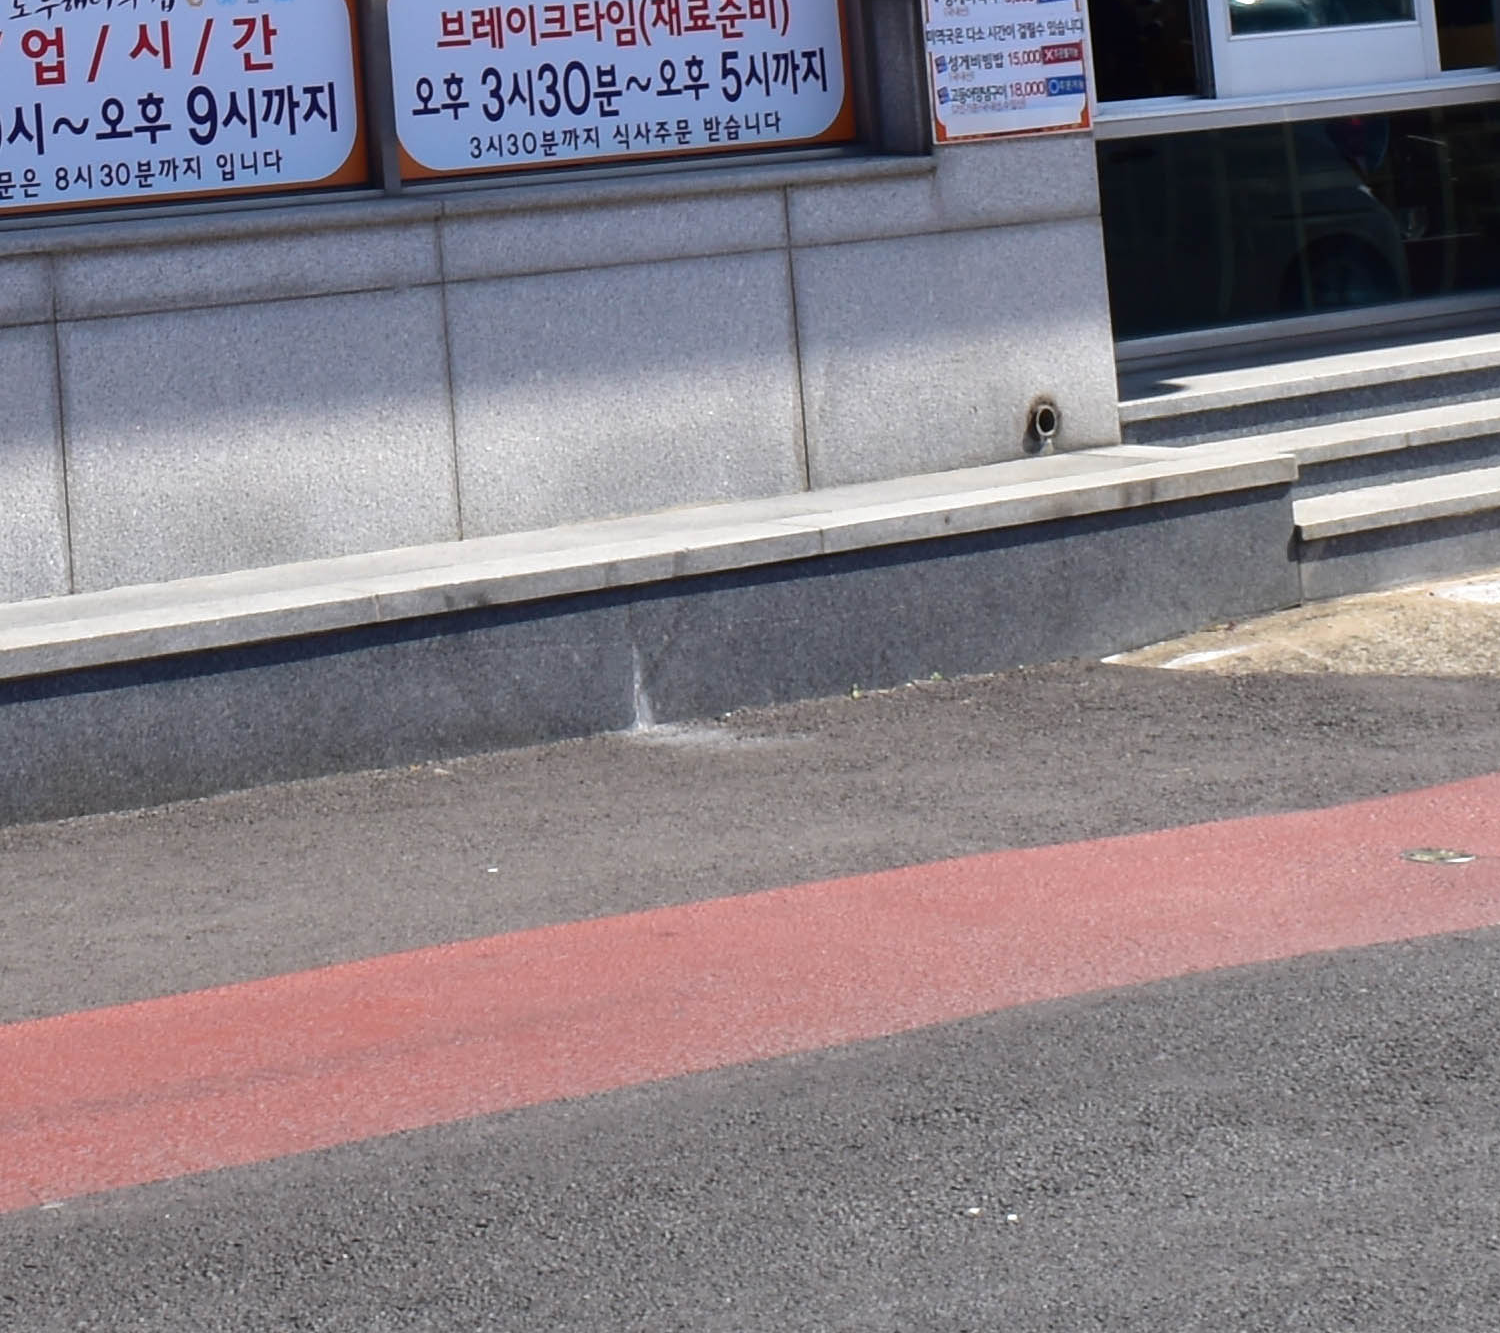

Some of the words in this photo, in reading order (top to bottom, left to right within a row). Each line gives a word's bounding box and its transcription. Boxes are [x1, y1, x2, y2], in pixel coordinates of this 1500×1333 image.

[1008, 50, 1041, 67] 15,000
[412, 72, 470, 120] 오후
[721, 46, 828, 102] 5시까지
[1009, 82, 1045, 97] 18,000
[186, 81, 339, 146] 9시까지
[470, 126, 601, 159] 3시30분까지
[613, 119, 692, 148] 식사주문
[704, 111, 782, 142] 받습니다
[55, 155, 202, 192] 8시30분까지
[216, 150, 283, 182] 입니다
